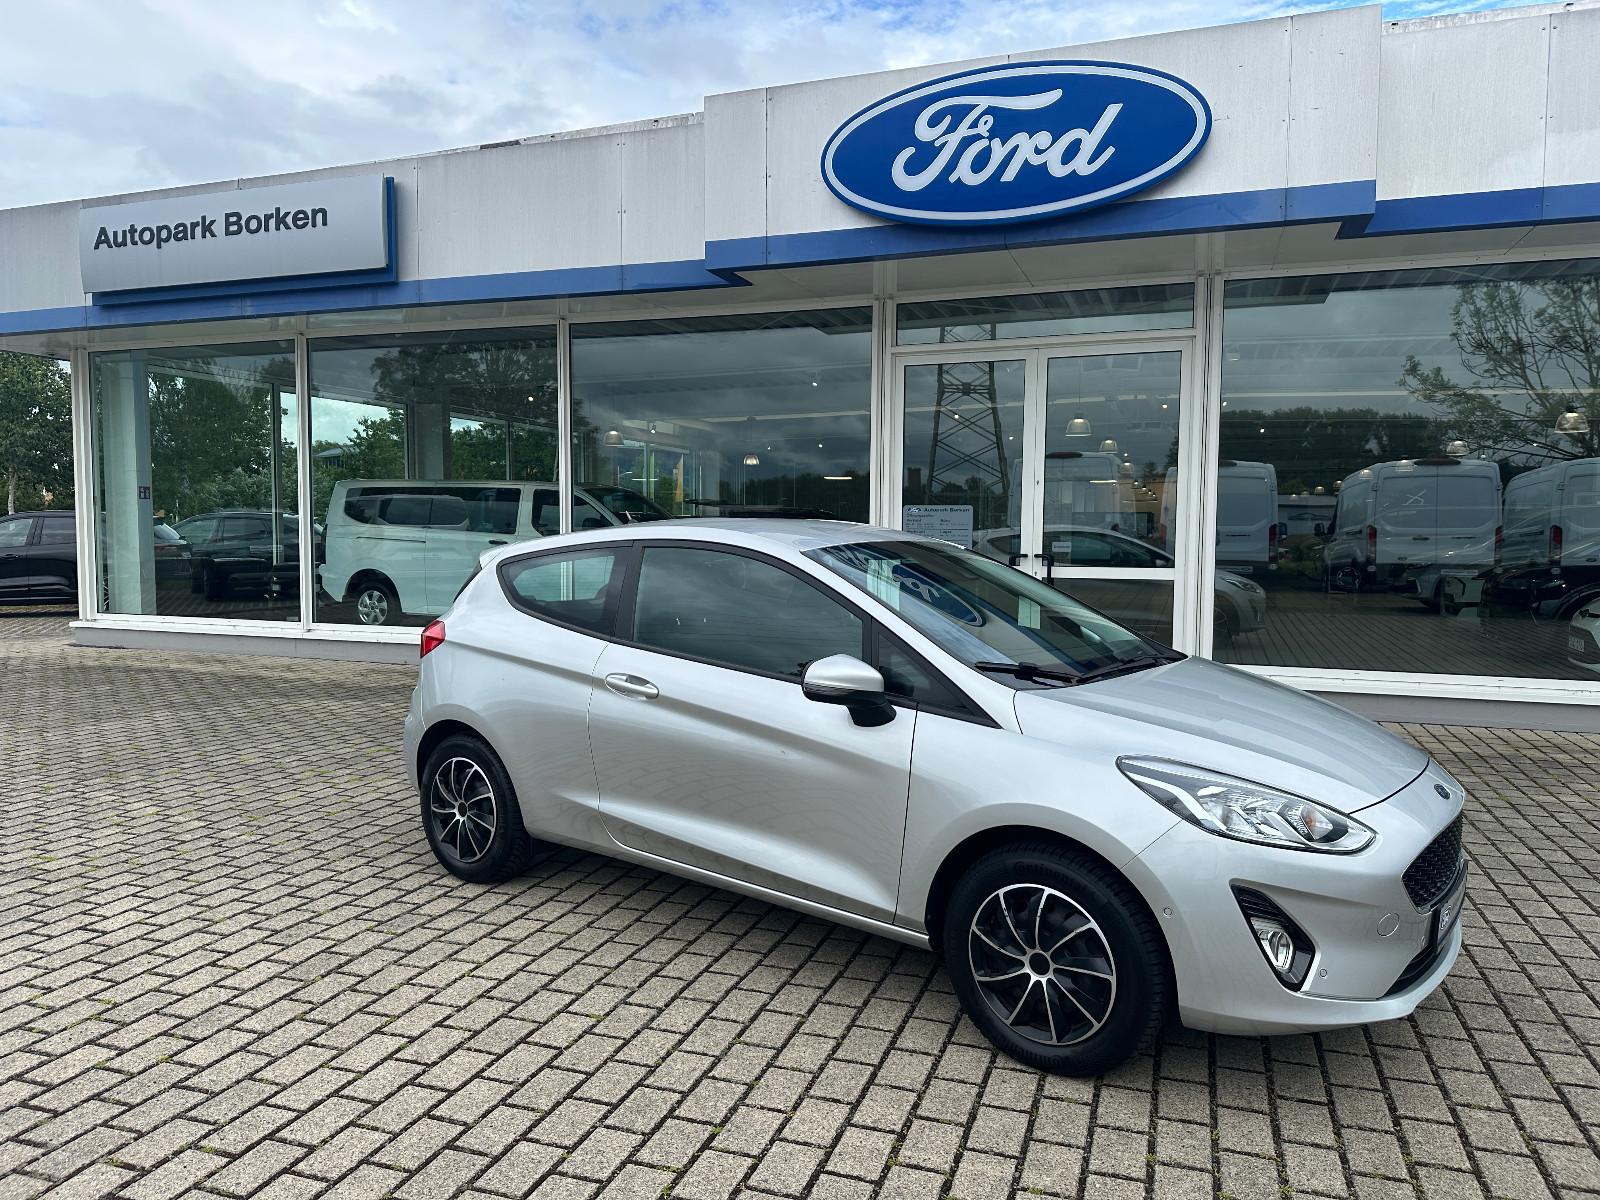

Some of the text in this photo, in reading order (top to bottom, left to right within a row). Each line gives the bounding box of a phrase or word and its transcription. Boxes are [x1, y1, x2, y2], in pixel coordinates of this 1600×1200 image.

[891, 88, 1124, 192] Ford
[93, 206, 327, 250] Autopark Borken
